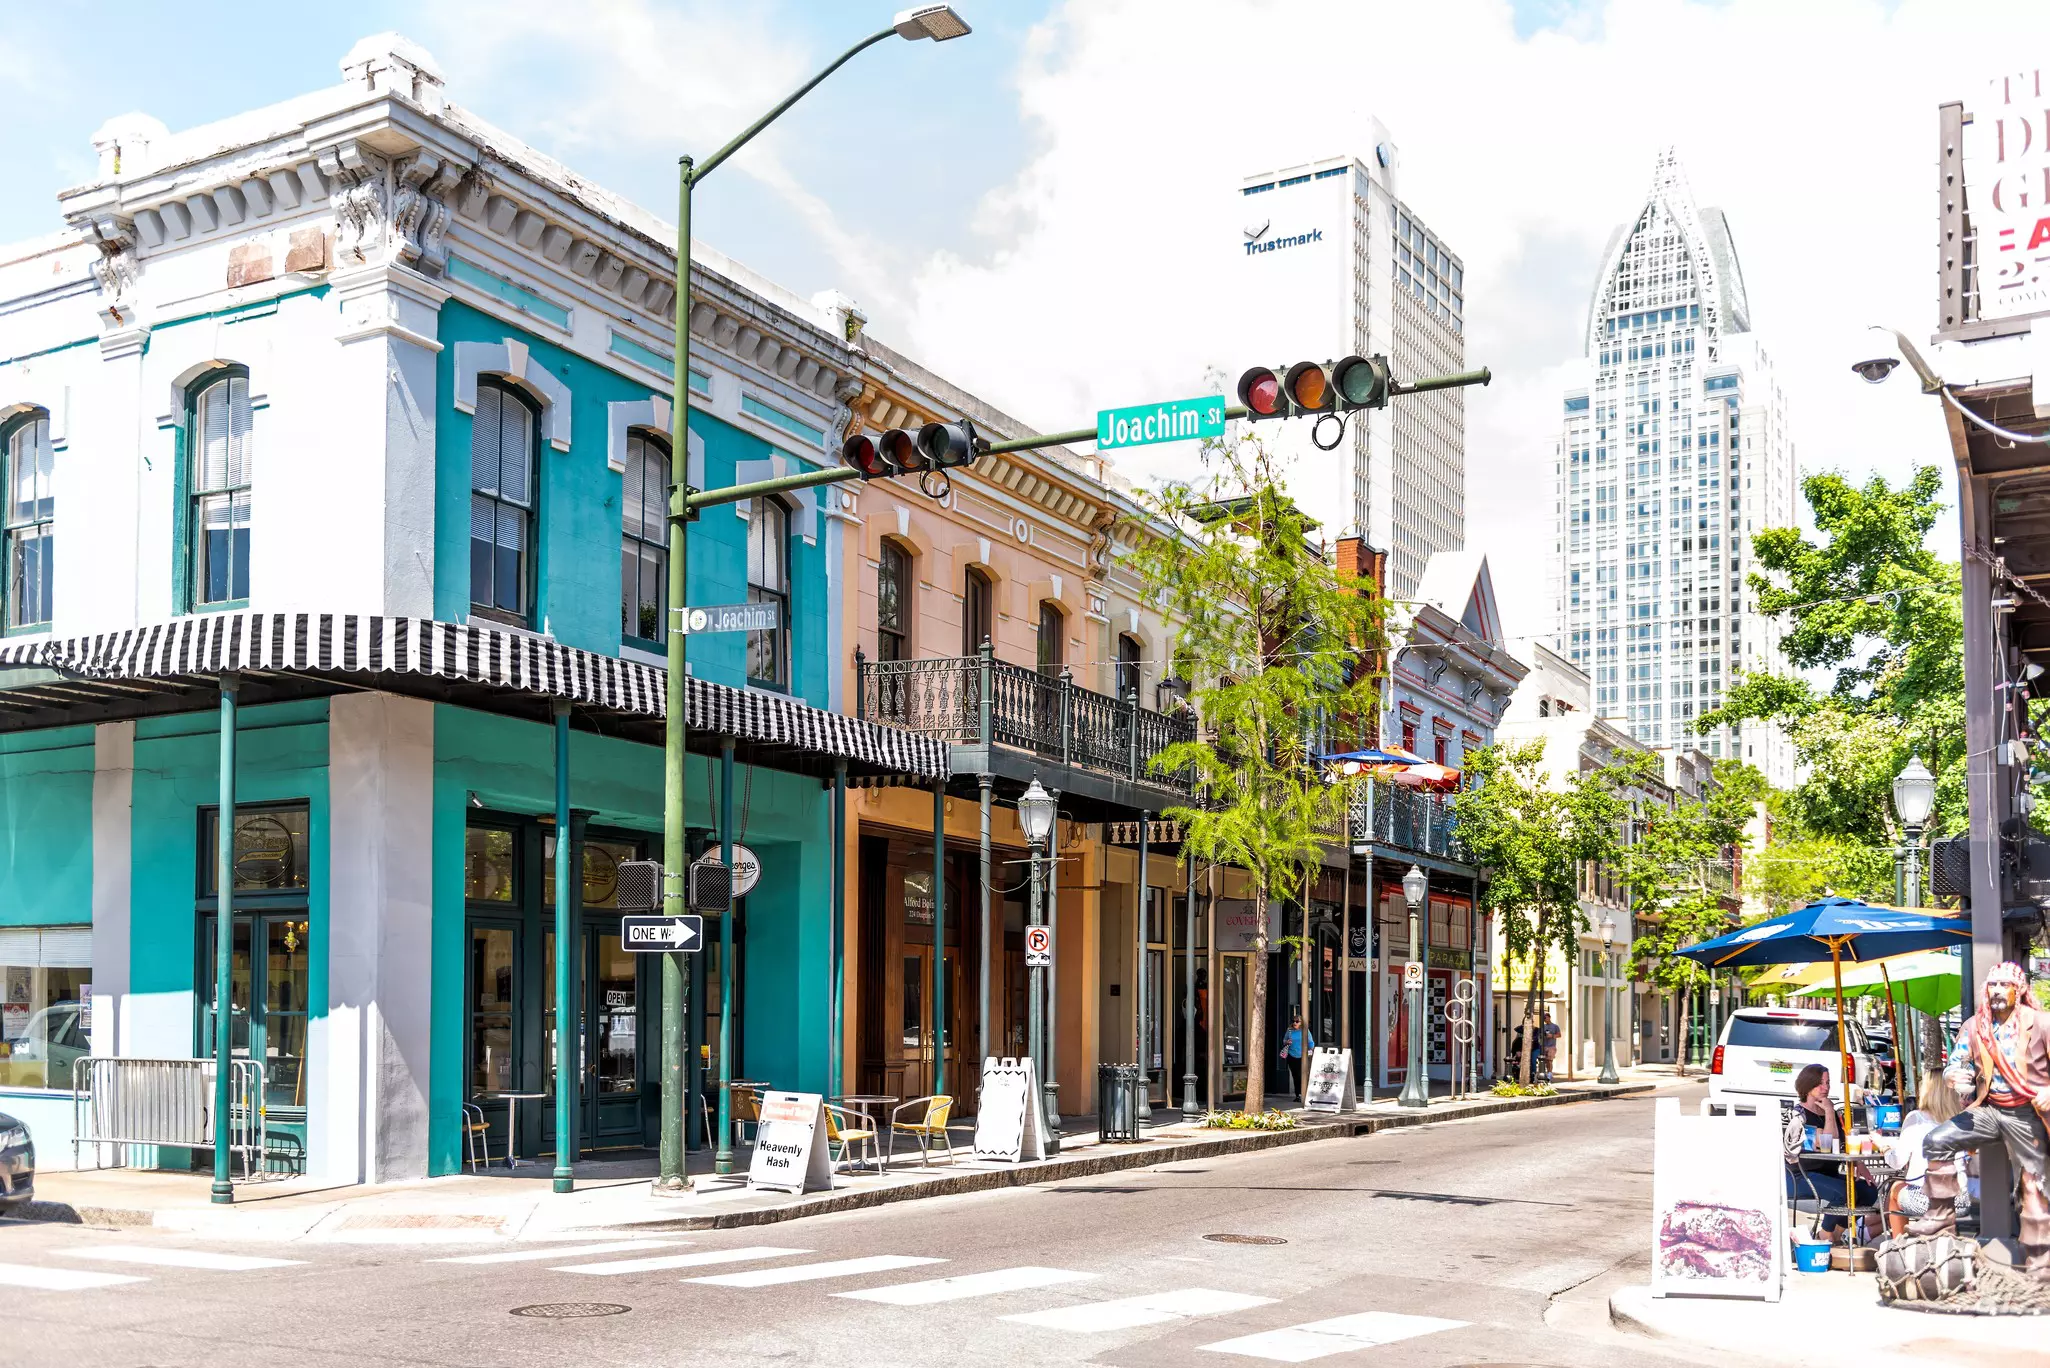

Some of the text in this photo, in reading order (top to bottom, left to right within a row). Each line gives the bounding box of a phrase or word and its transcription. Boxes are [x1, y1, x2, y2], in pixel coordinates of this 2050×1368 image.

[1243, 228, 1323, 256] Trustmark
[1101, 405, 1221, 446] Joachim St
[714, 607, 767, 629] Joachim
[767, 610, 775, 620] St
[632, 927, 656, 941] ONE
[607, 991, 626, 1005] OPEN
[759, 1140, 803, 1158] Heavenly
[766, 1155, 790, 1169] Hash
